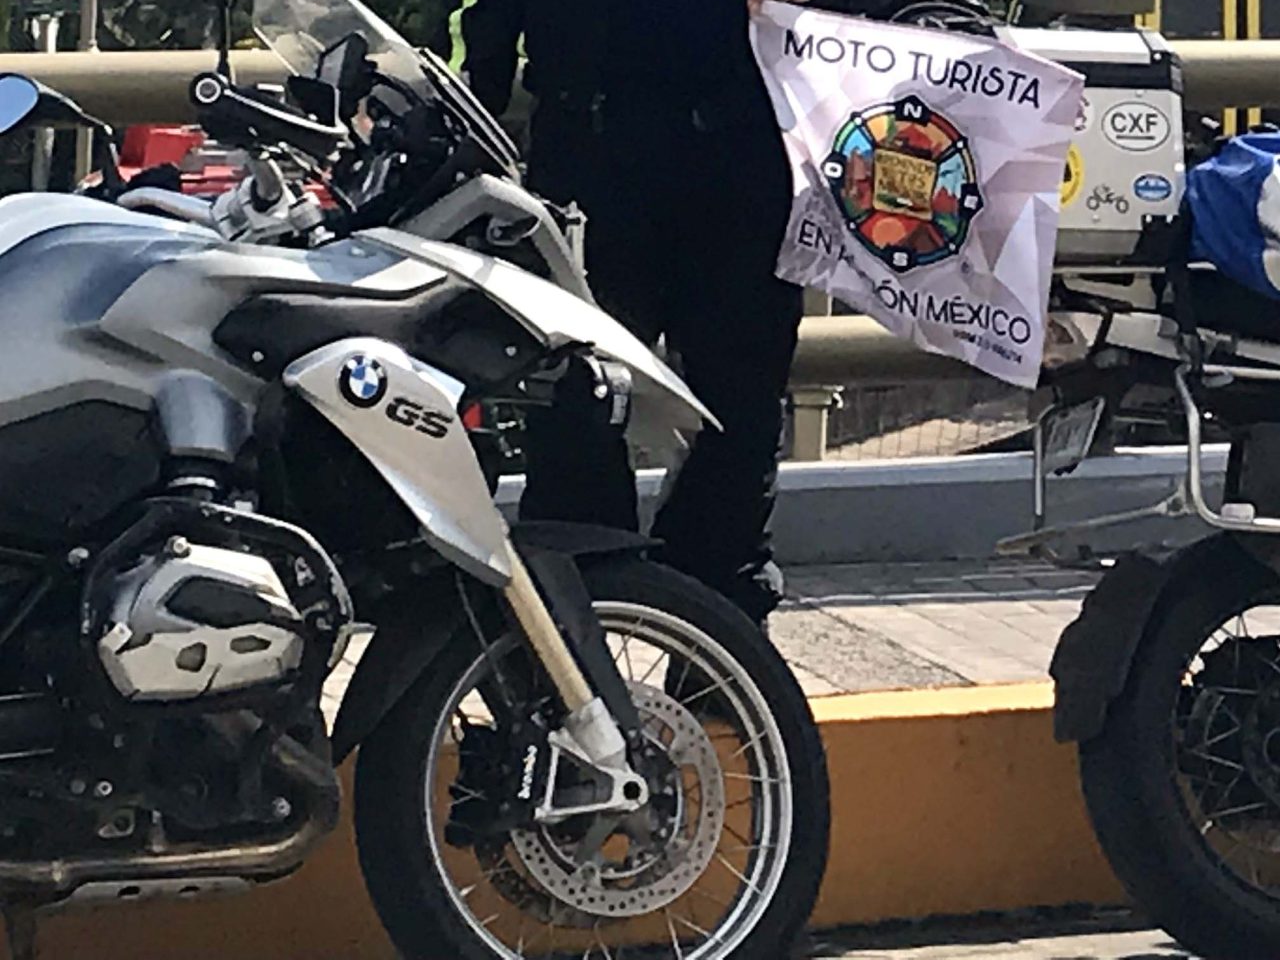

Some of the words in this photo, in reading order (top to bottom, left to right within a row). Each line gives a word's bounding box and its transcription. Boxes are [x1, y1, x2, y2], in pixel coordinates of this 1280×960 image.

[784, 29, 896, 73] MOTO
[907, 51, 1041, 109] TURISTA
[903, 103, 922, 118] N
[1110, 112, 1158, 133] CXF
[798, 219, 833, 255] EN
[926, 295, 1031, 344] MÉXICO
[386, 395, 453, 438] GS
